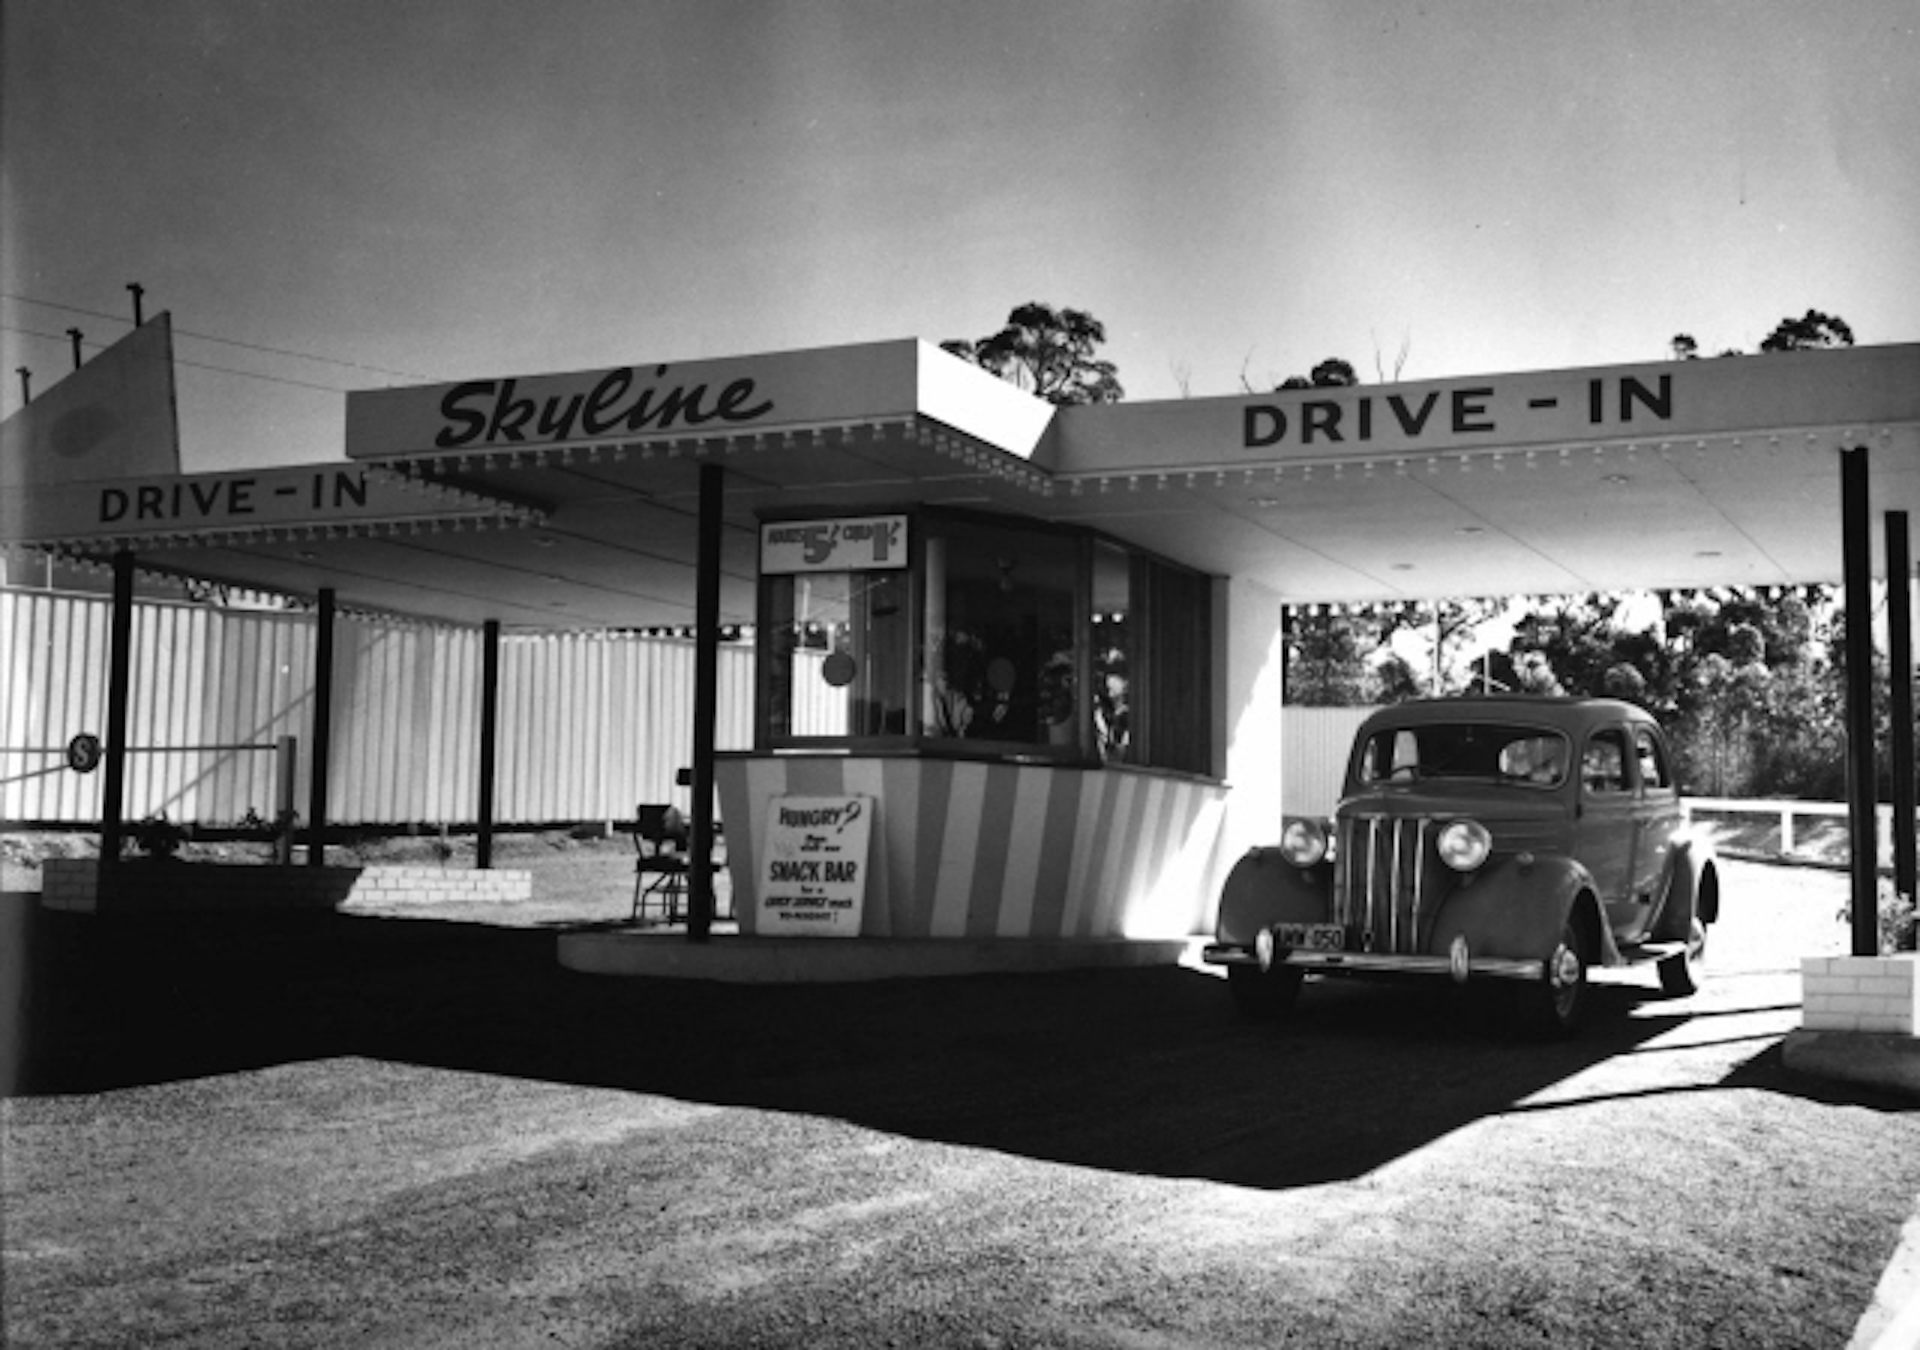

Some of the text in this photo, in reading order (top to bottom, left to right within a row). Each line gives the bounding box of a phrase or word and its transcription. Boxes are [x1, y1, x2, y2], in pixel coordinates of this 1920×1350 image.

[434, 363, 775, 447] Skyline
[1243, 386, 1496, 448] DRIVE
[1590, 373, 1672, 424] IN
[99, 478, 256, 523] DRIVE
[312, 470, 367, 510] IN
[770, 861, 857, 883] SNACK BAR
